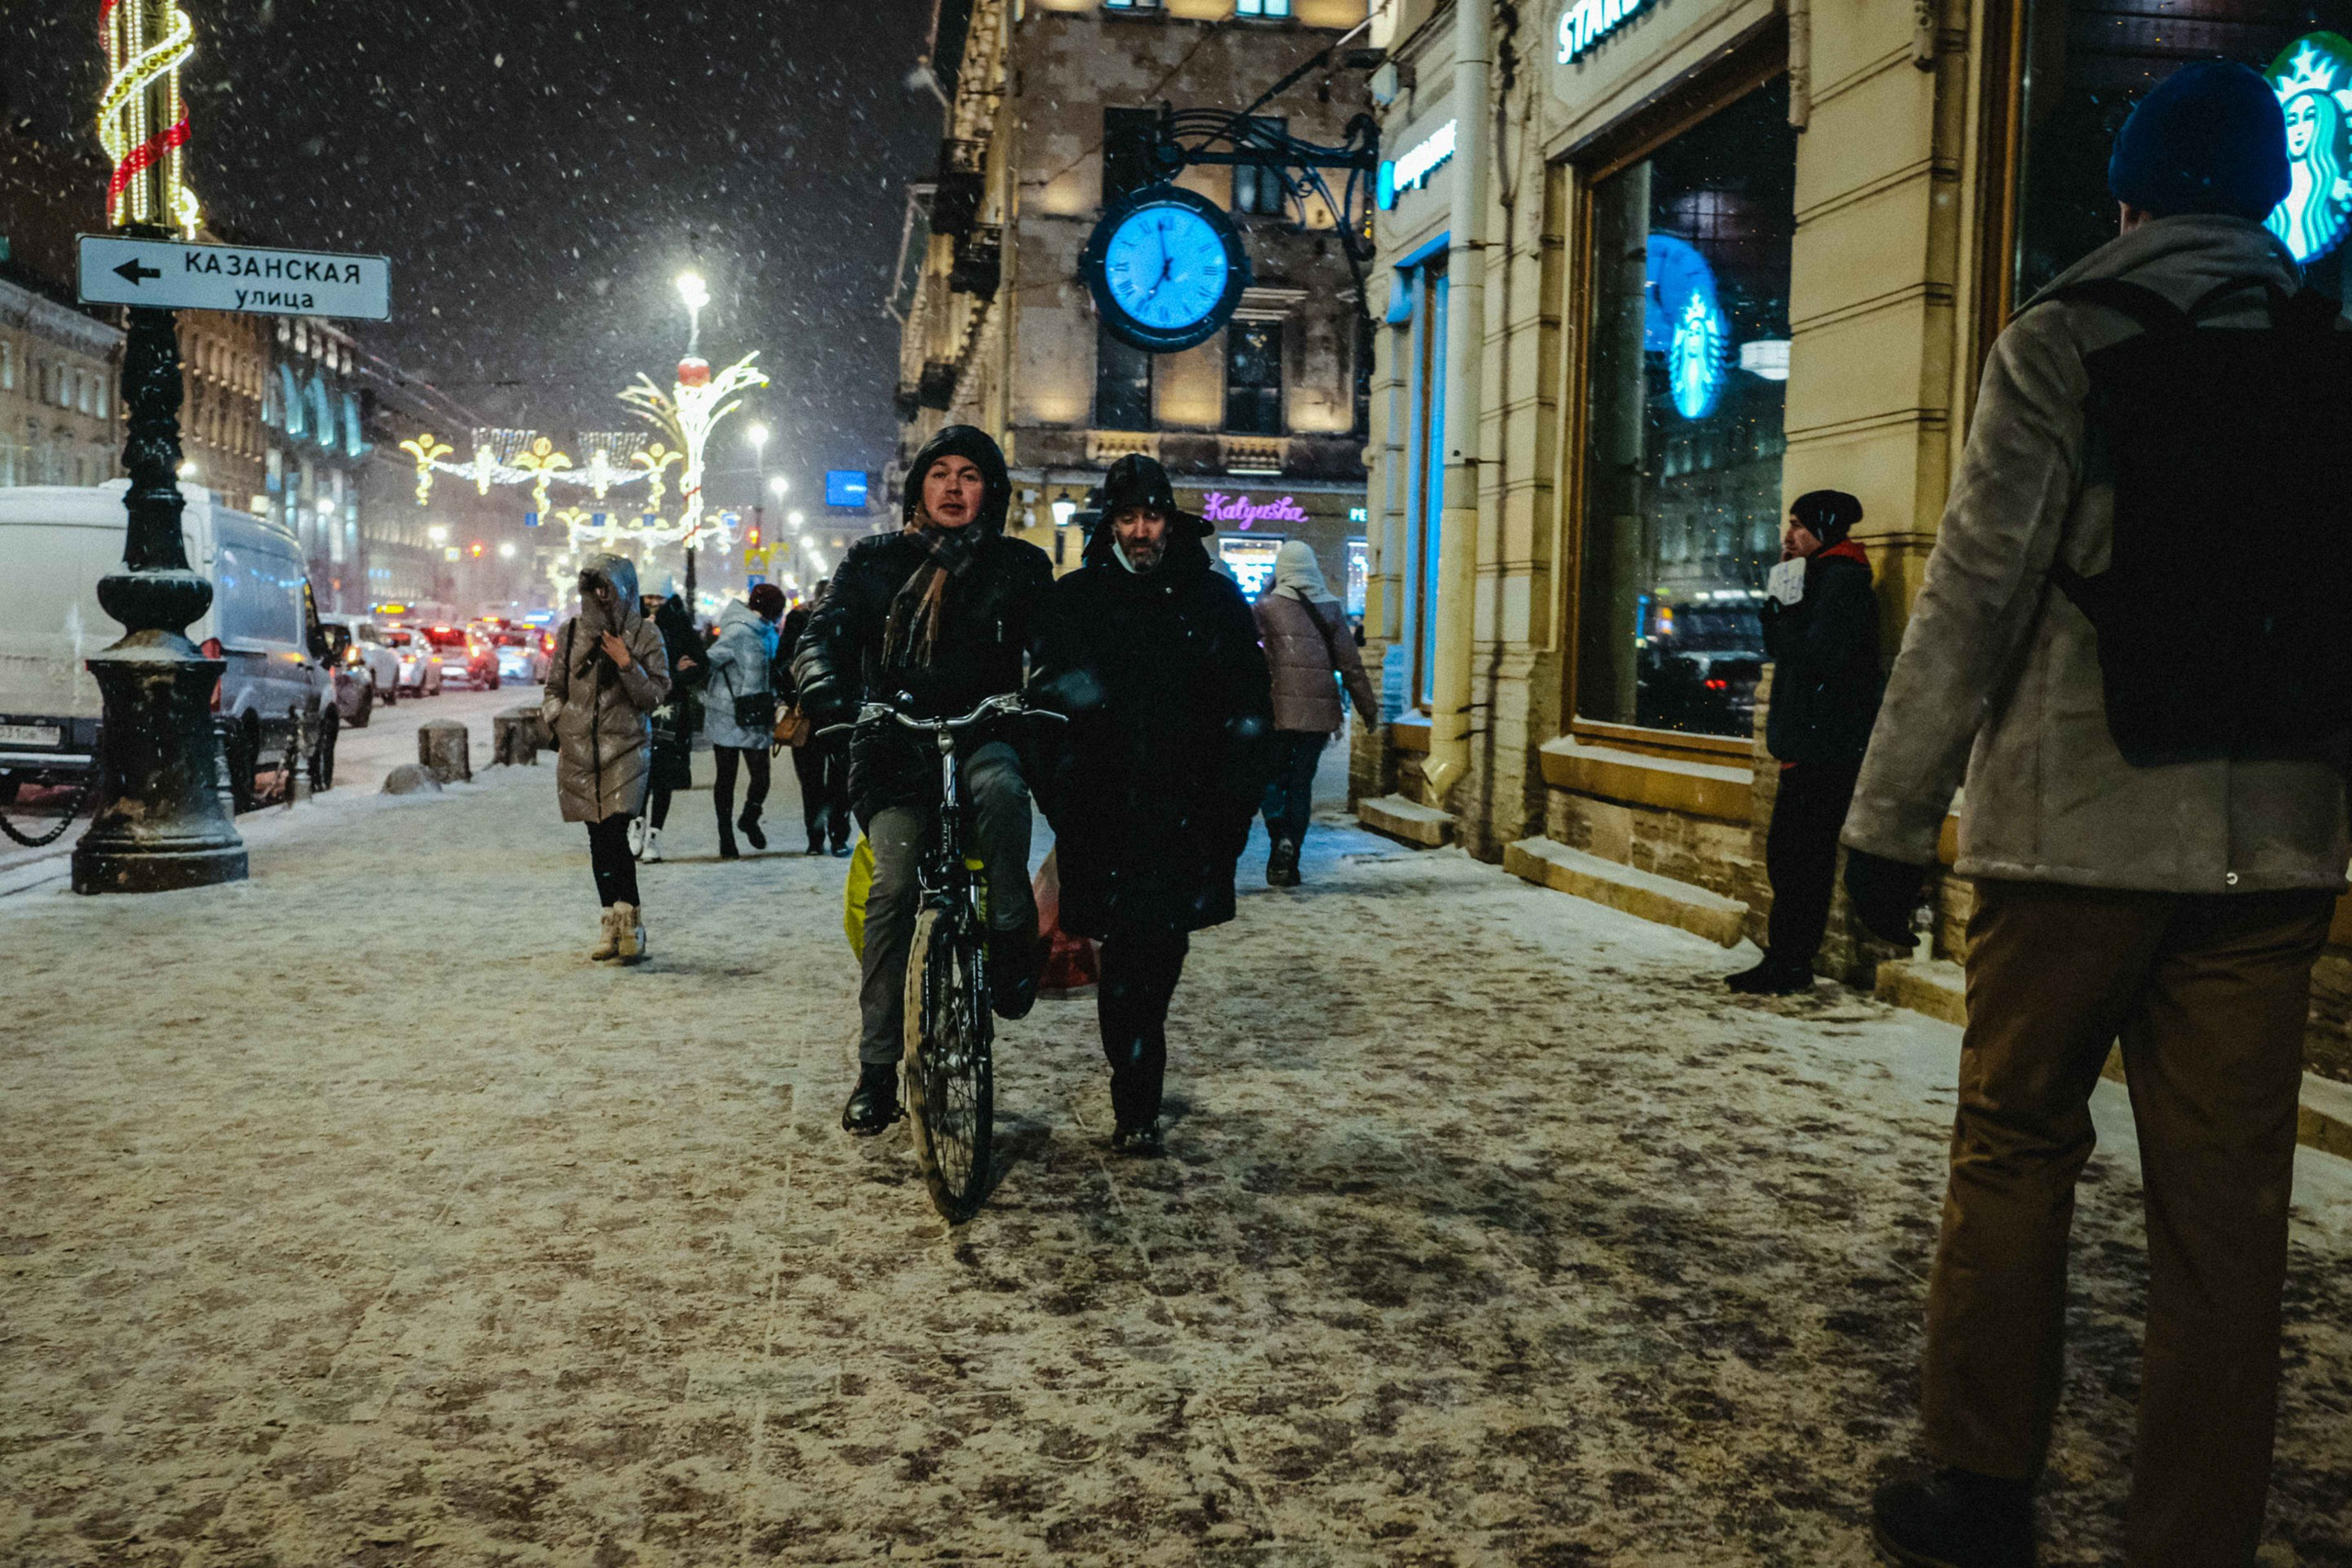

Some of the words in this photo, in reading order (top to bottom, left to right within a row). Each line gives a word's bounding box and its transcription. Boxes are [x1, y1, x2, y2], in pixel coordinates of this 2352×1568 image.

[186, 252, 360, 284] КАЗАНСКАЯ
[235, 289, 314, 310] улица
[1203, 491, 1309, 530] Katyusha
